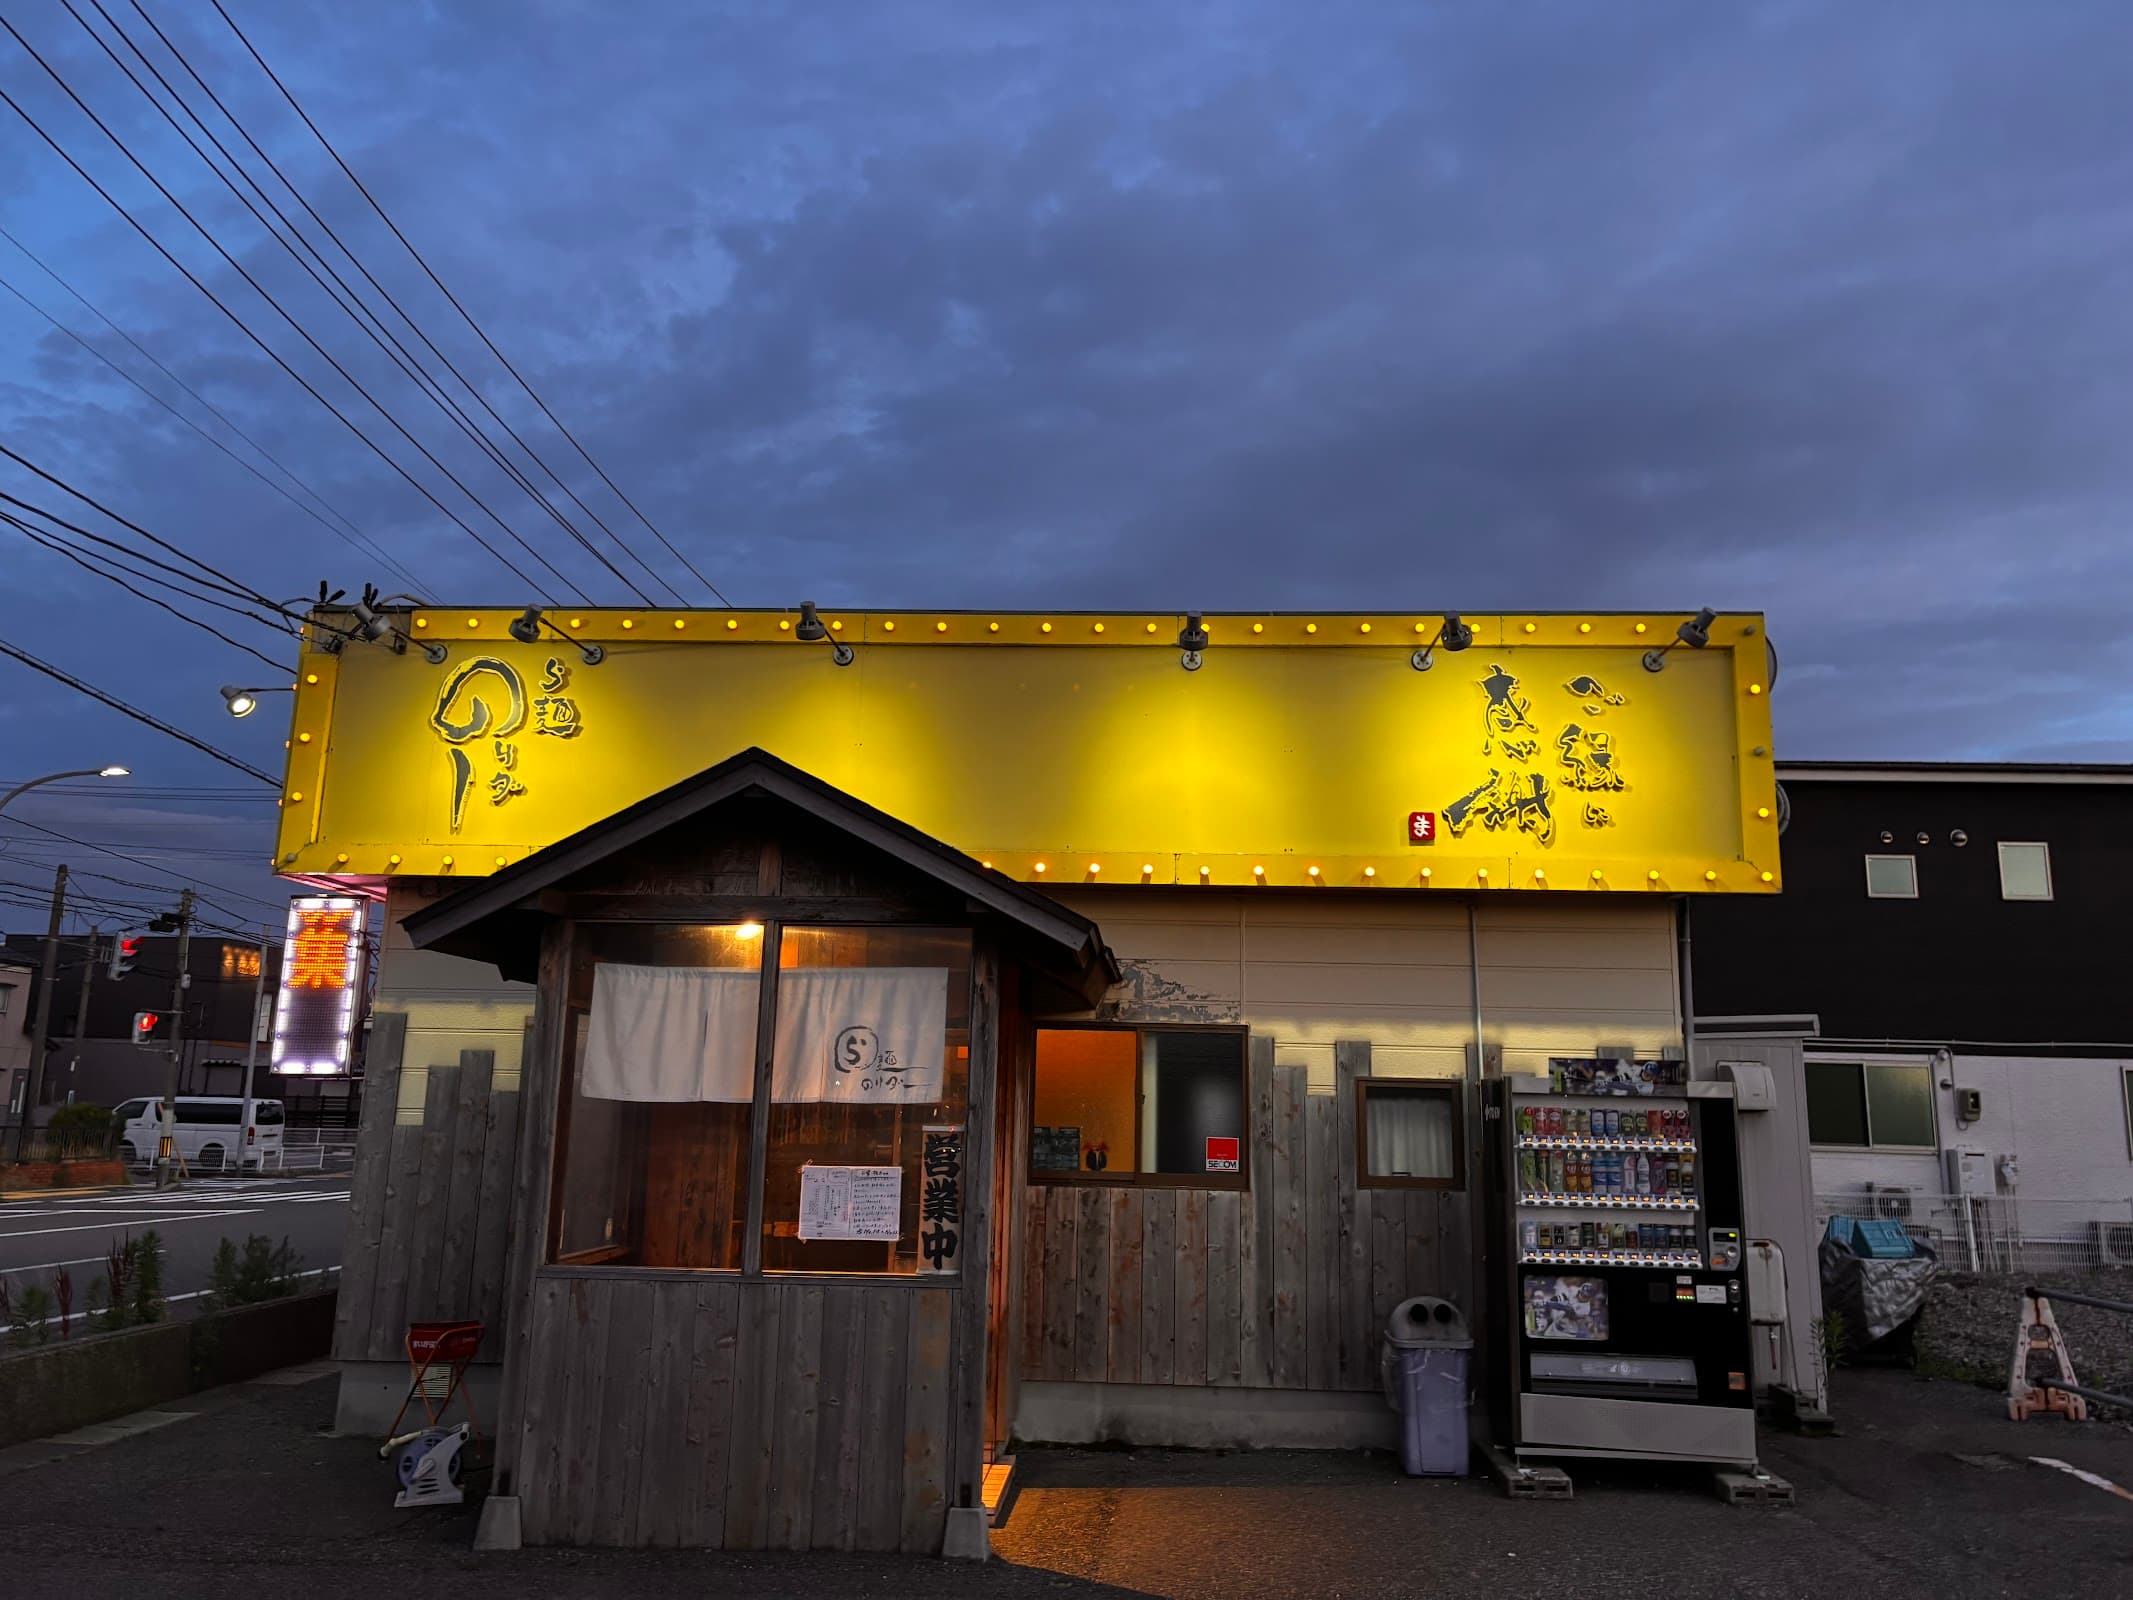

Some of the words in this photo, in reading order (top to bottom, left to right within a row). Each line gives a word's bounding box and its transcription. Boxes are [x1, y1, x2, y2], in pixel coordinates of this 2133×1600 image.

[533, 656, 582, 739] ら麺
[922, 1133, 961, 1270] 営業中
[1208, 1160, 1237, 1169] SECOM
